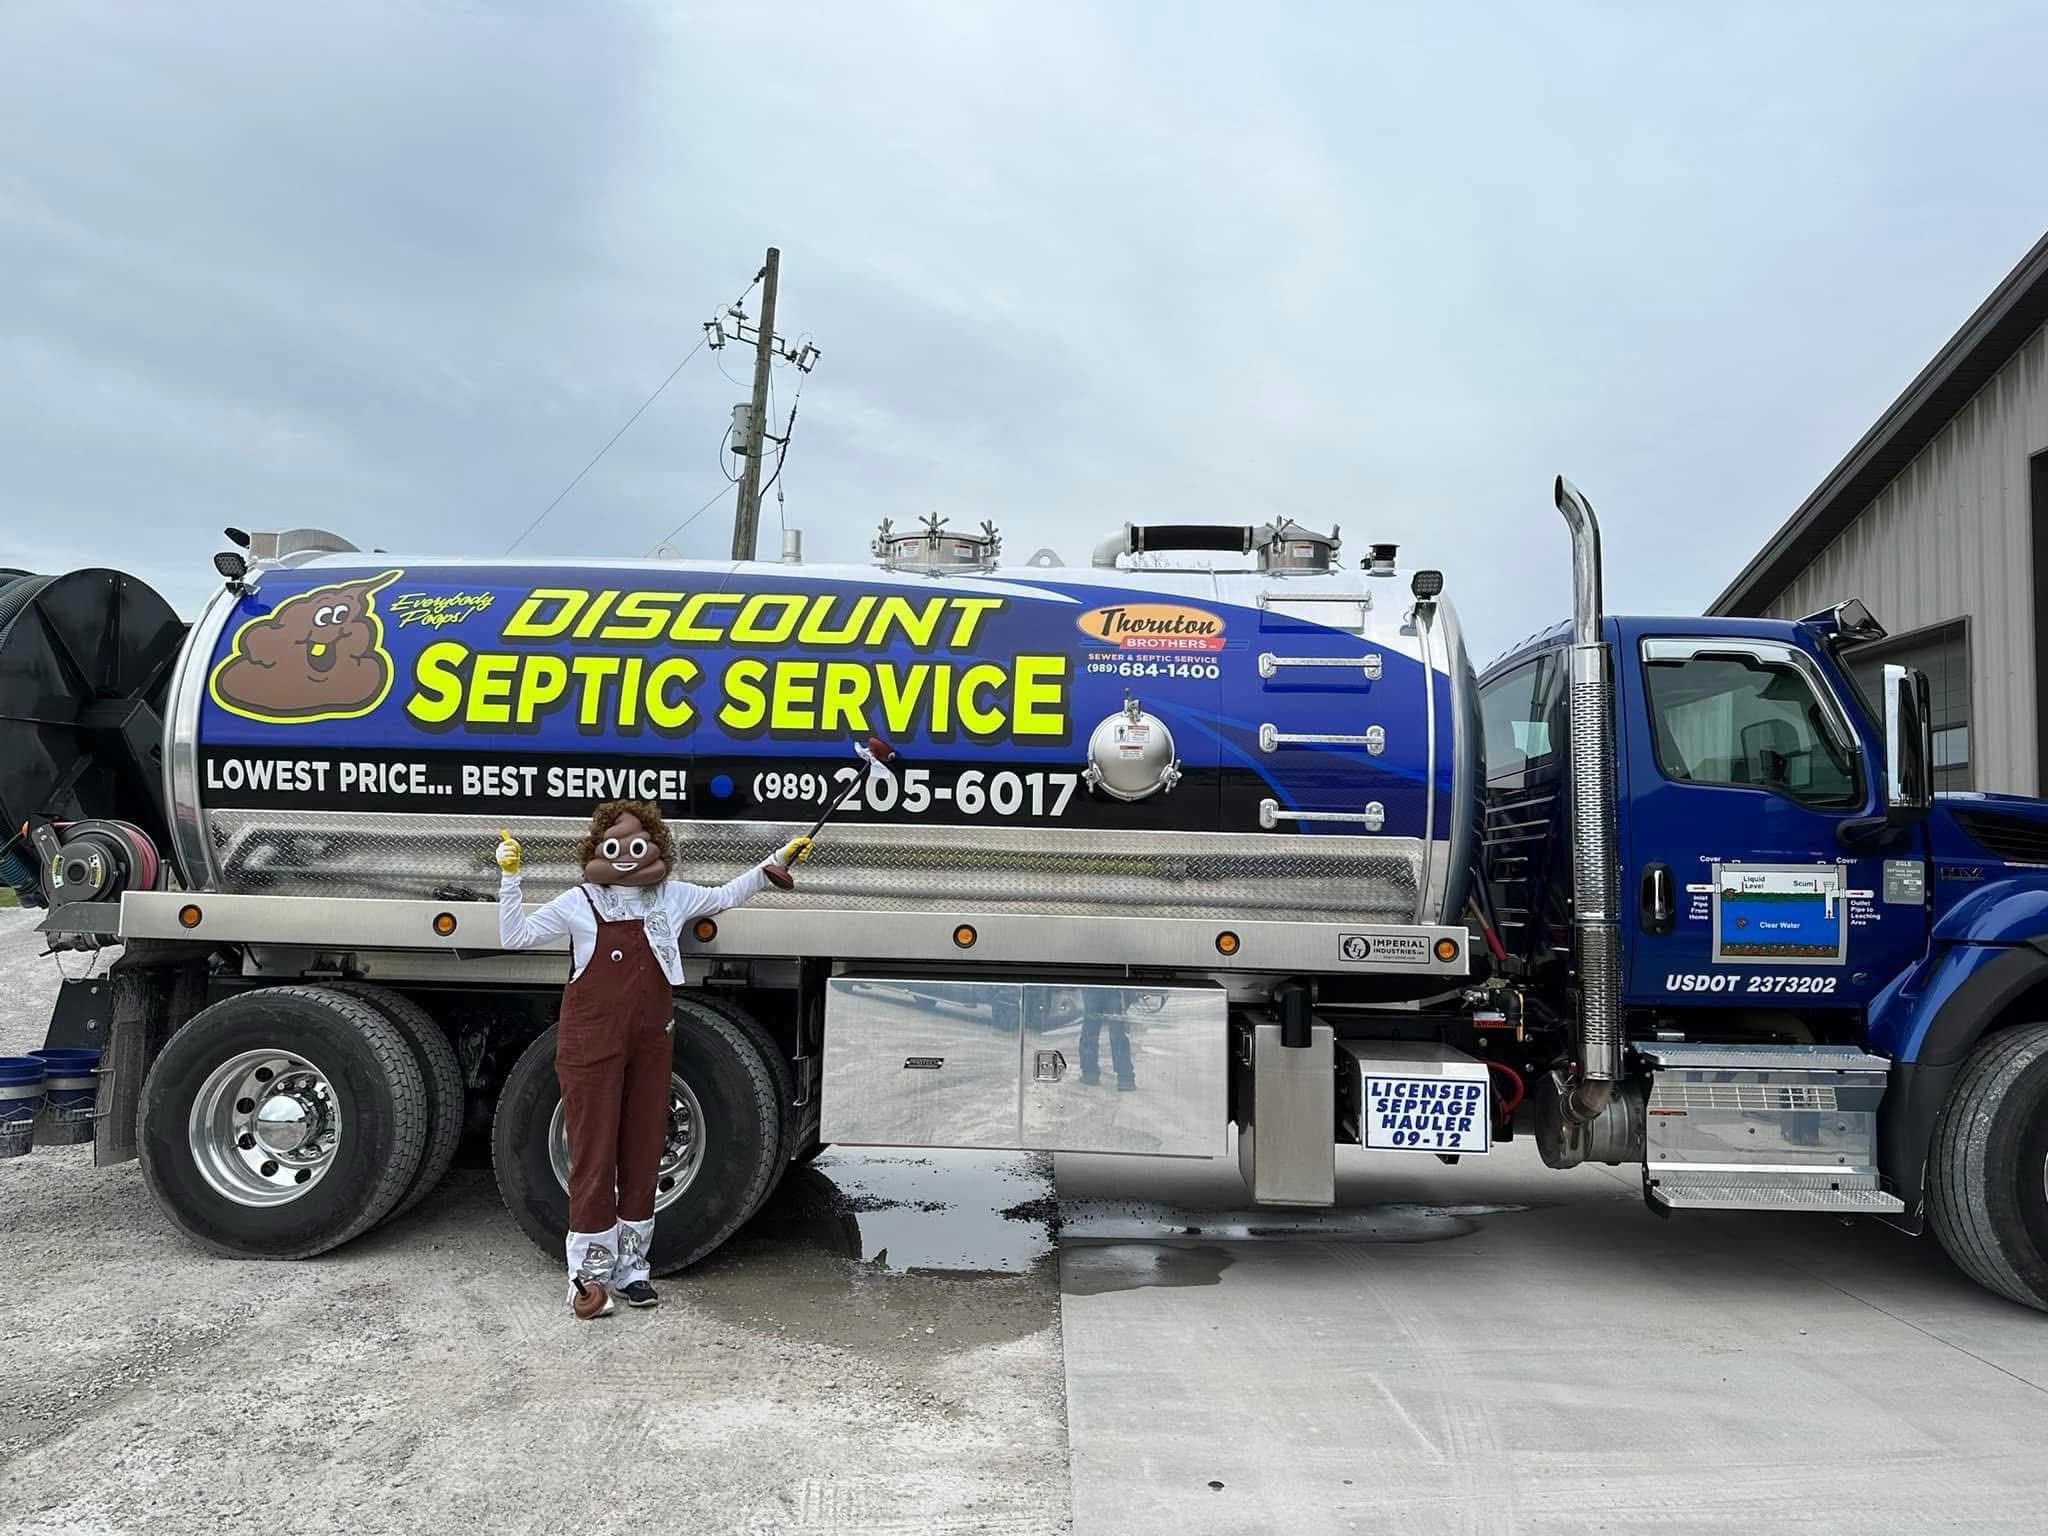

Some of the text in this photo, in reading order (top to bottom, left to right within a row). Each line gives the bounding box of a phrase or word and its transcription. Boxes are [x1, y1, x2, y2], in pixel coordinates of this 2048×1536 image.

[390, 592, 495, 612] Everybody
[399, 606, 476, 630] Poops!
[502, 590, 1004, 647] DISCOUNT
[1099, 608, 1217, 637] Thornton
[1126, 638, 1208, 649] BROTHERS
[1088, 653, 1124, 661] SEWER
[1136, 654, 1171, 662] SEPTIC
[1174, 656, 1218, 664] SERVICE
[1087, 662, 1220, 679] (989) 684-1400
[407, 642, 1067, 736] SEPTIC SERVICE
[207, 759, 687, 800] LOWEST PRICE... BEST SERVICE!
[752, 767, 1078, 817] (989) 205-6017
[1743, 875, 1766, 883] Liquid
[1759, 921, 1800, 929] Clear Water
[1373, 939, 1425, 948] IMPERIAL
[1666, 974, 1837, 993] USDOT 2373202
[1371, 1082, 1481, 1100] LICENSED
[1376, 1099, 1477, 1116] SEPTAGE
[1381, 1114, 1472, 1132] HAULER
[1392, 1131, 1462, 1148] 09-12
